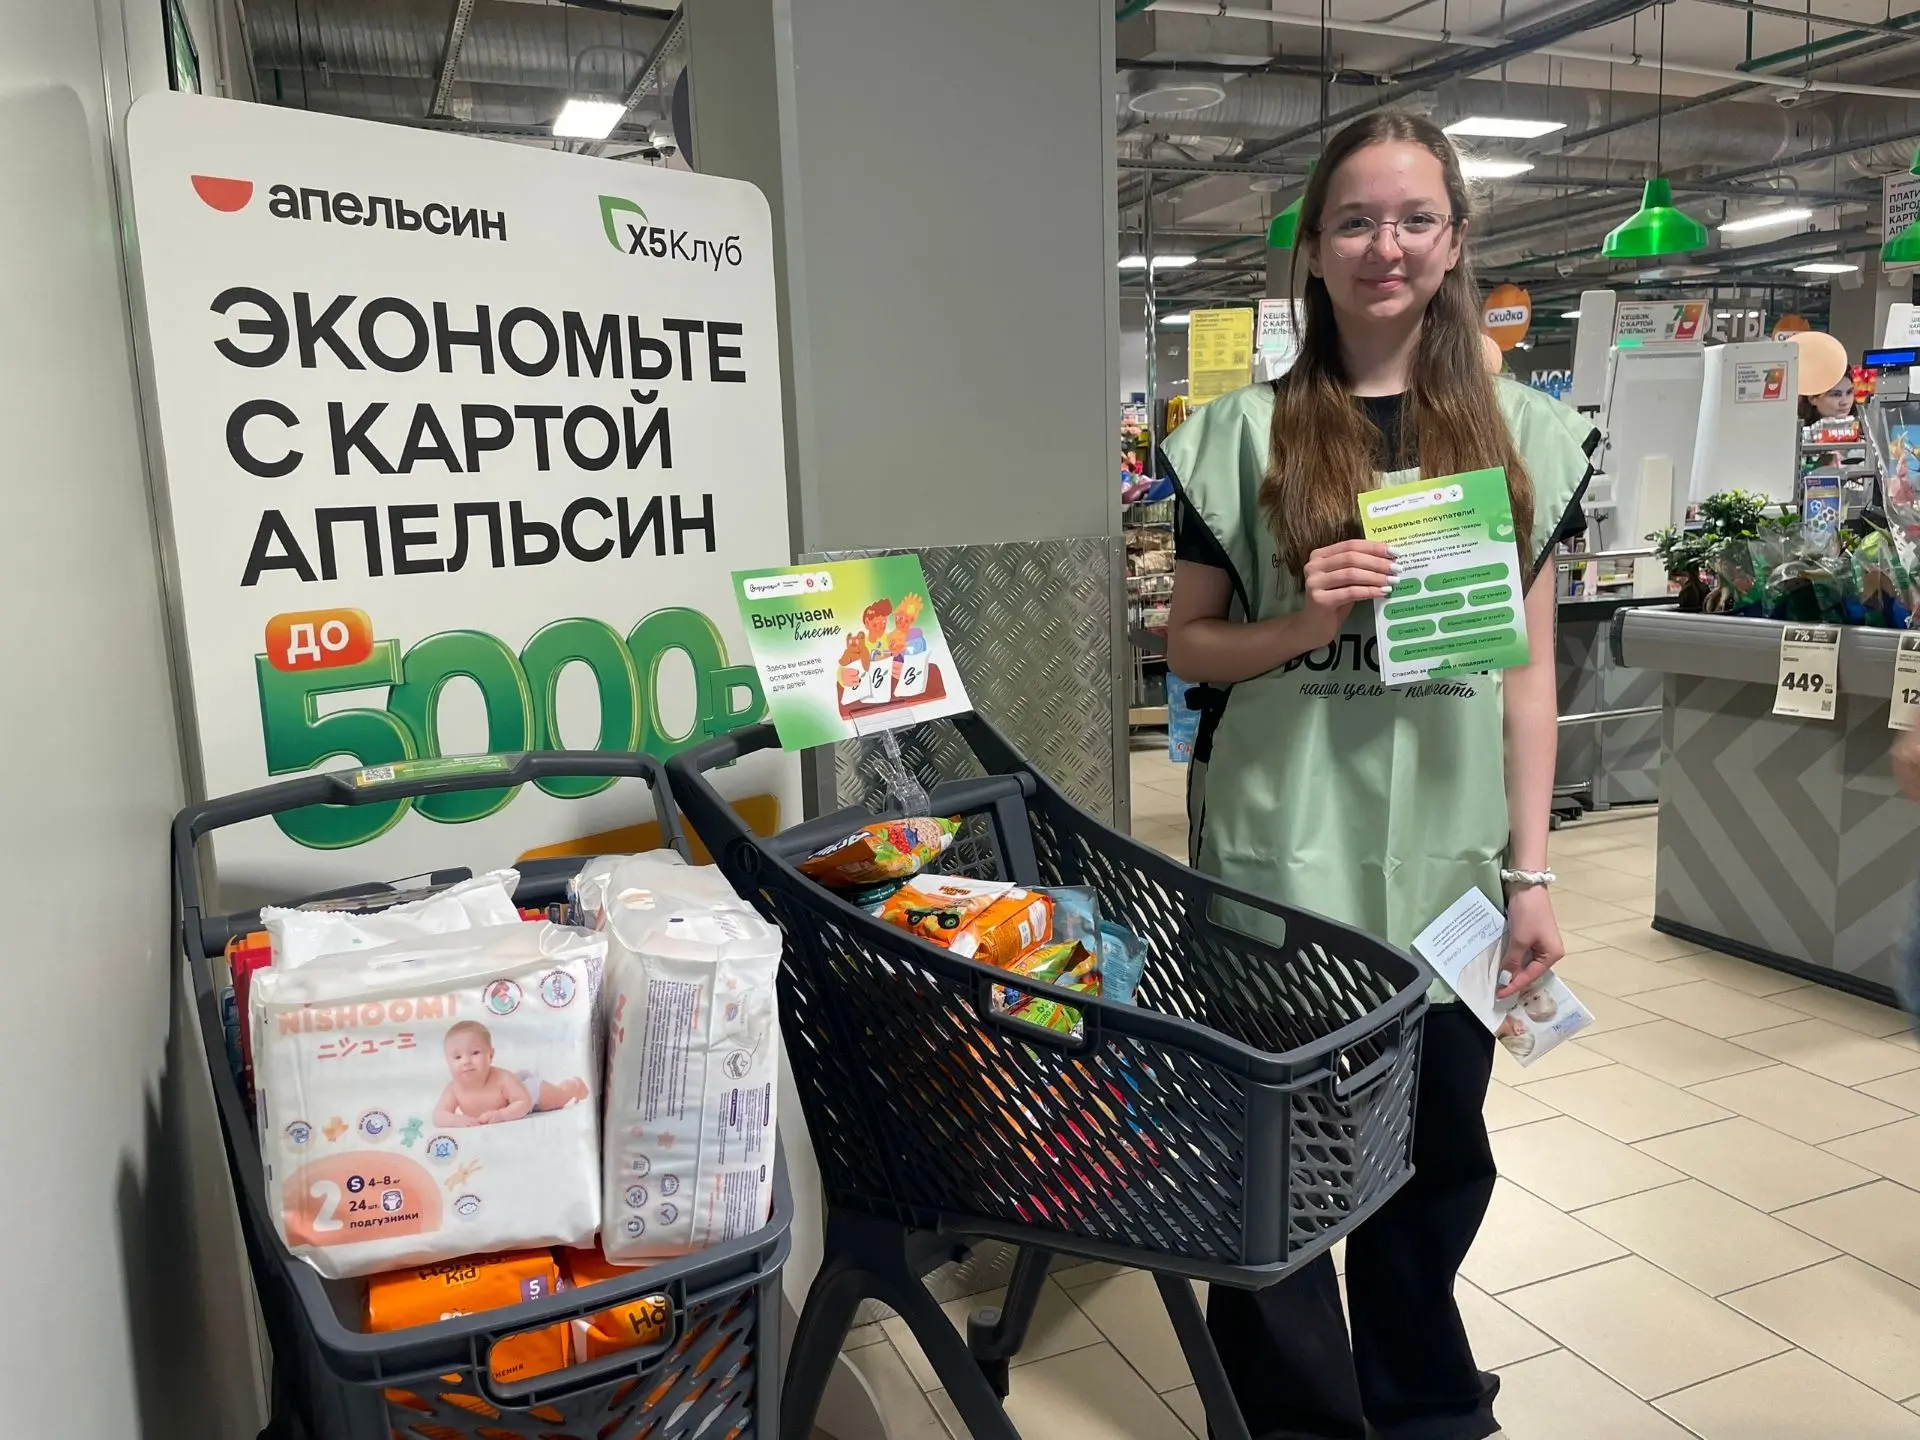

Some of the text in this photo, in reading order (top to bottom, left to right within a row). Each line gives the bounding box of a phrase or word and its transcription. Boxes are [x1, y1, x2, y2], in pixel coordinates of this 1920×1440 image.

[268, 183, 507, 242] апельсин
[1263, 312, 1290, 320] КЕШБЭ
[1488, 310, 1523, 323] Скидка
[209, 286, 747, 384] ЭКОНОМЬТЕ
[1619, 327, 1656, 335] АПЕЛЬСИН
[226, 389, 673, 478] С КАРТОЙ
[1371, 508, 1475, 534] Уважаемые покупатели!
[240, 494, 717, 587] АПЕЛЬСИН
[1408, 530, 1436, 539] собираем
[752, 608, 834, 630] Выручаем
[795, 621, 841, 641] вместе
[1793, 629, 1810, 641] 7%
[287, 620, 350, 664] ДО
[766, 664, 786, 673] Здесь
[798, 658, 822, 667] можете
[769, 667, 824, 682] оставить товары
[1392, 669, 1418, 678] Спасибо
[1427, 664, 1452, 674] участие
[1458, 657, 1495, 668] поддержку!
[786, 679, 807, 690] детей
[1299, 682, 1340, 699] наша
[1343, 683, 1386, 700] цель
[1782, 671, 1824, 693] 449
[350, 1178, 362, 1191] S
[310, 1180, 344, 1232] 2
[349, 1200, 367, 1212] 24
[350, 1212, 419, 1230] подгузники
[445, 1266, 477, 1285] Kid
[529, 1279, 541, 1296] 5
[494, 1362, 524, 1379] НЕНИЯ
